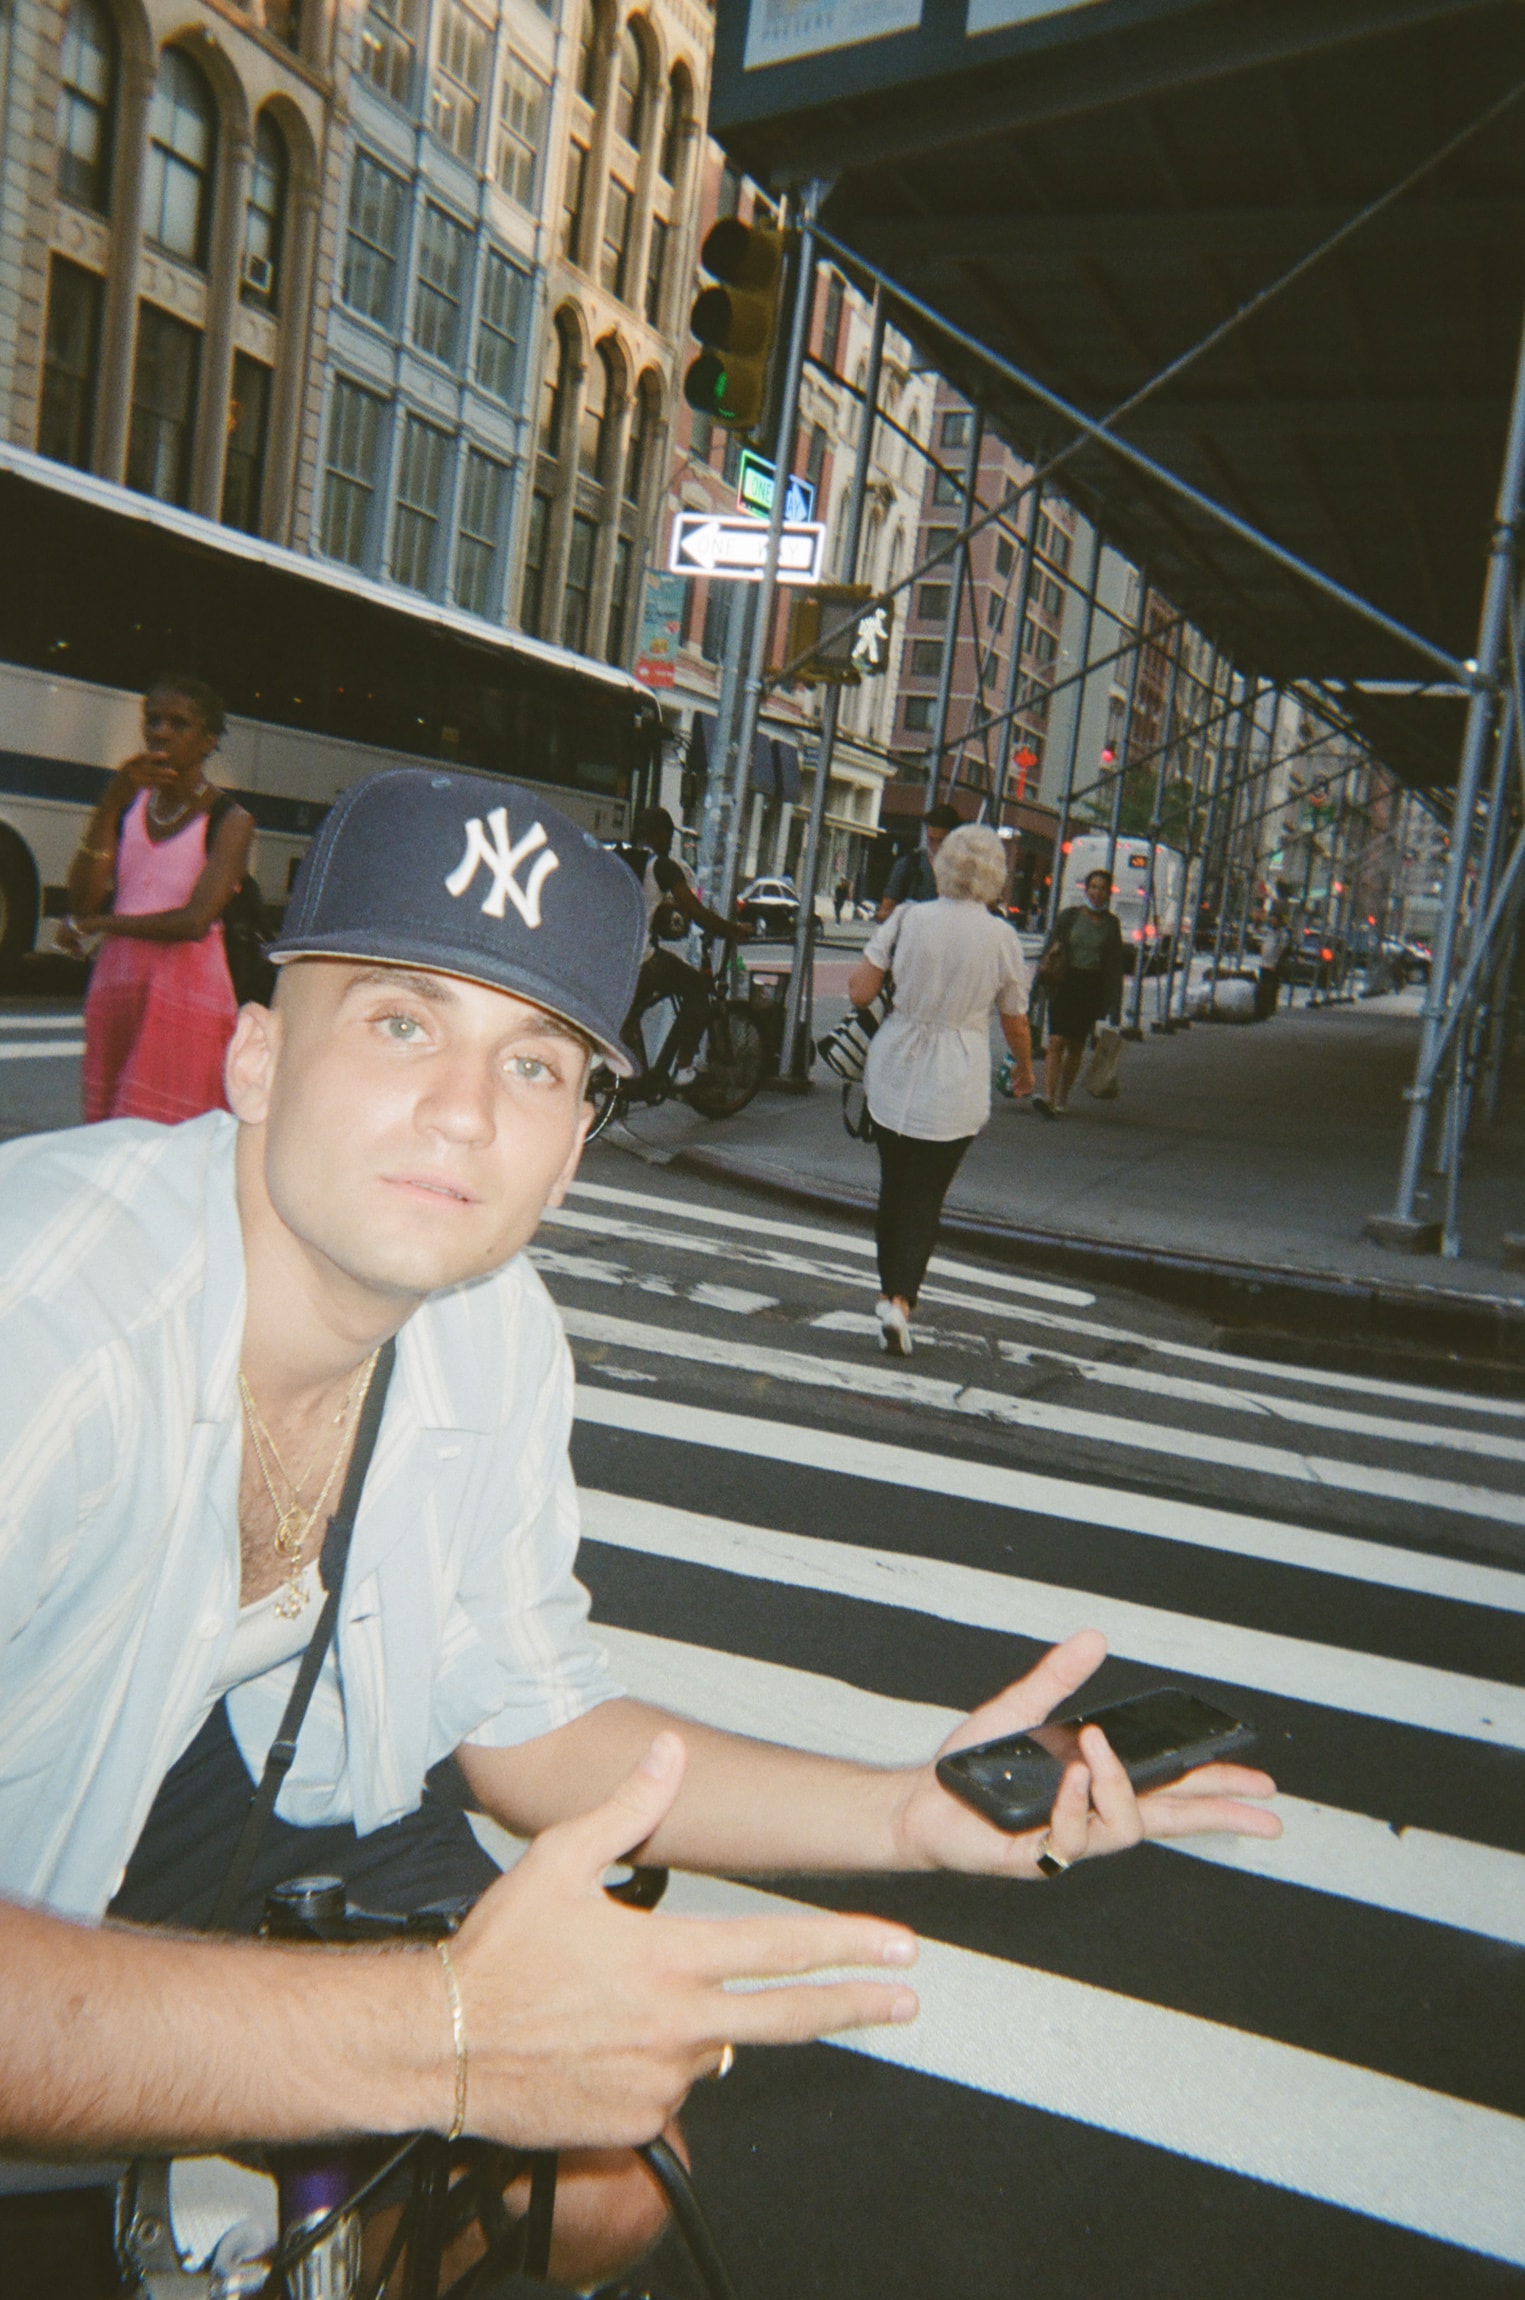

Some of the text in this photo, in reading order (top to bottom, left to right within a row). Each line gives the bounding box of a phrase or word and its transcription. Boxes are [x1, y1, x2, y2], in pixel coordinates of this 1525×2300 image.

[751, 476, 773, 504] ONE
[696, 535, 737, 557] ONE
[445, 806, 560, 929] NY
